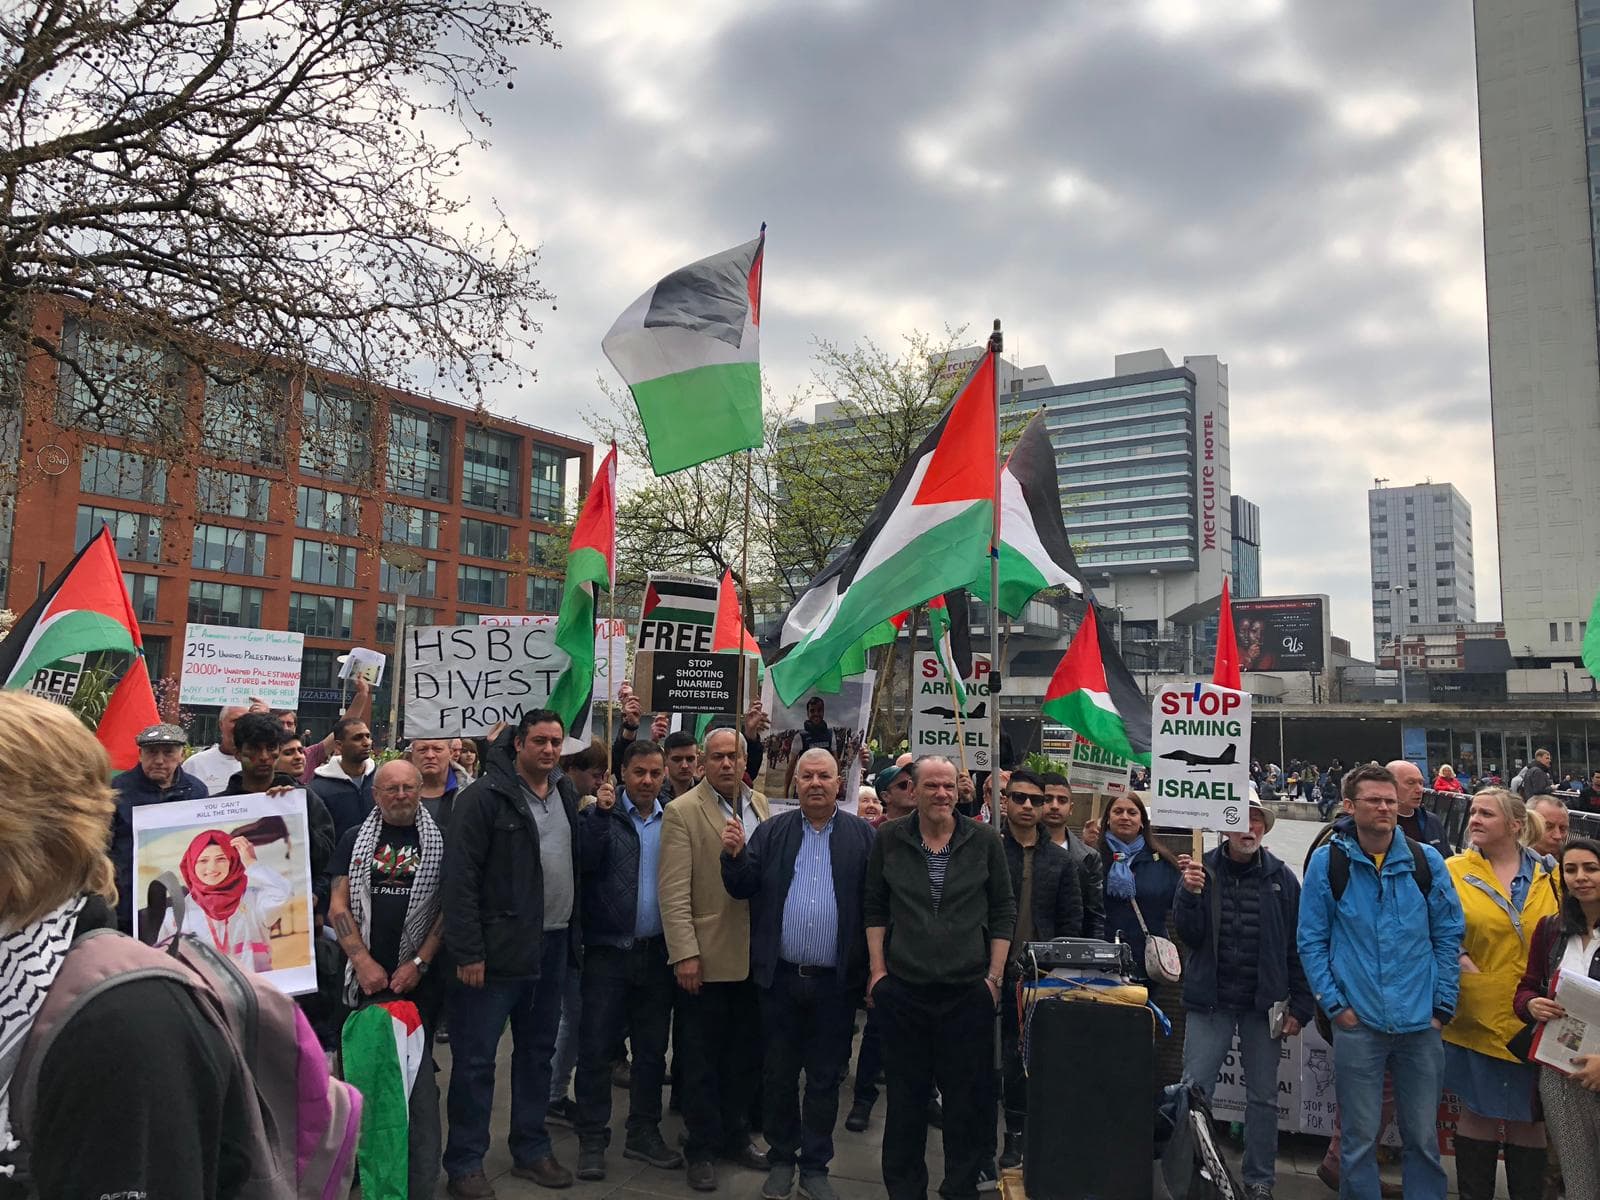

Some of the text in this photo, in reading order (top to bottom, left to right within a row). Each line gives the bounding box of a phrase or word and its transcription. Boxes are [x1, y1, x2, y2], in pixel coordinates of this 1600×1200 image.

[1204, 411, 1213, 460] HOTEL
[414, 629, 552, 662] HSBC
[639, 621, 713, 652] FREE
[187, 642, 216, 658] 295
[688, 659, 713, 667] STOP
[30, 668, 78, 695] REE
[676, 669, 724, 679] SHOOTING
[676, 679, 723, 689] UNARMED
[414, 669, 560, 700] DIVEST
[668, 689, 730, 699] PROTESTERS
[921, 681, 991, 696] ARMNG
[1161, 692, 1241, 715] STOP
[440, 702, 524, 729] FROM
[1160, 719, 1241, 737] ARMING
[919, 730, 989, 748] ISRAEL
[1073, 742, 1128, 769] ISRAEL
[1157, 779, 1241, 801] ISRAEL
[380, 886, 411, 895] PALEST
